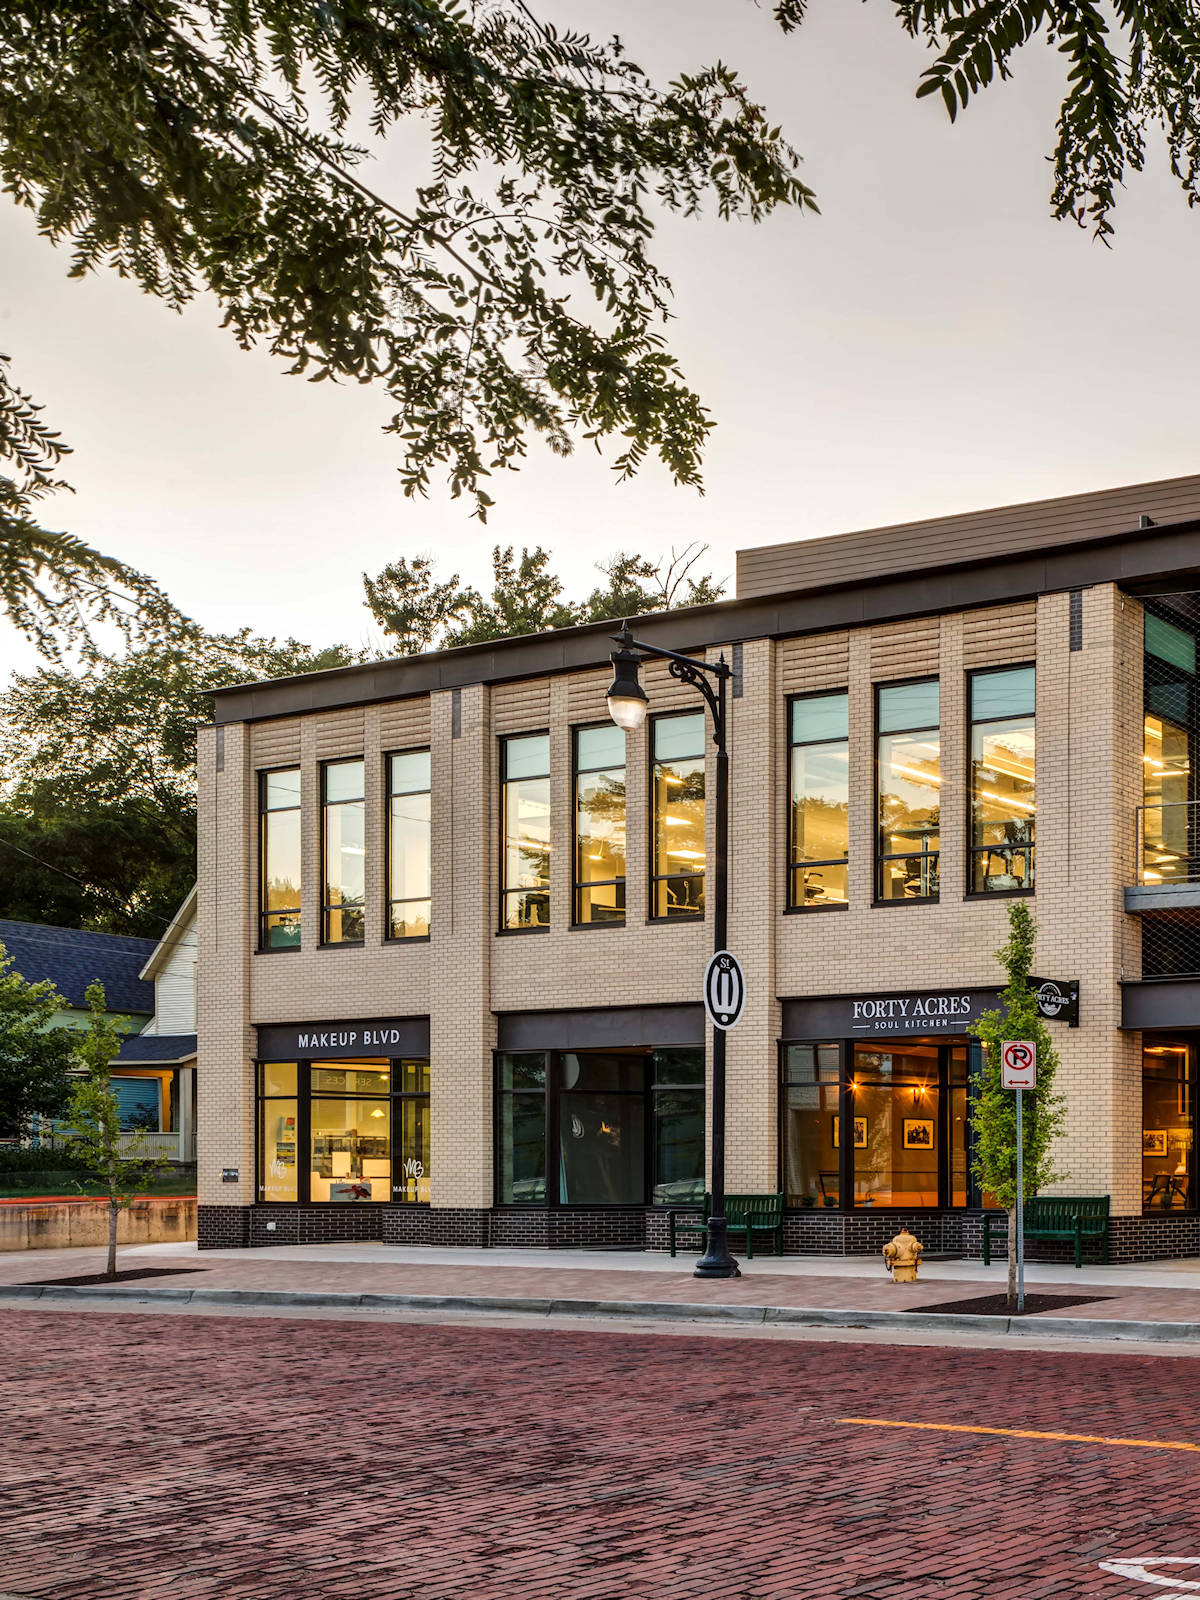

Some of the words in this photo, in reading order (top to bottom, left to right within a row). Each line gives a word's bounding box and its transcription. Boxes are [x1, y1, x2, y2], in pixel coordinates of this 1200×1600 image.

[852, 998, 911, 1019] FORTY
[912, 995, 971, 1016] ACRES
[874, 1020, 900, 1030] SOUL
[905, 1018, 948, 1028] KITCHEN
[298, 1031, 357, 1049] MAKEUP
[363, 1029, 400, 1045] BLVD
[1013, 1048, 1028, 1065] P
[392, 1185, 418, 1193] MAKEUP
